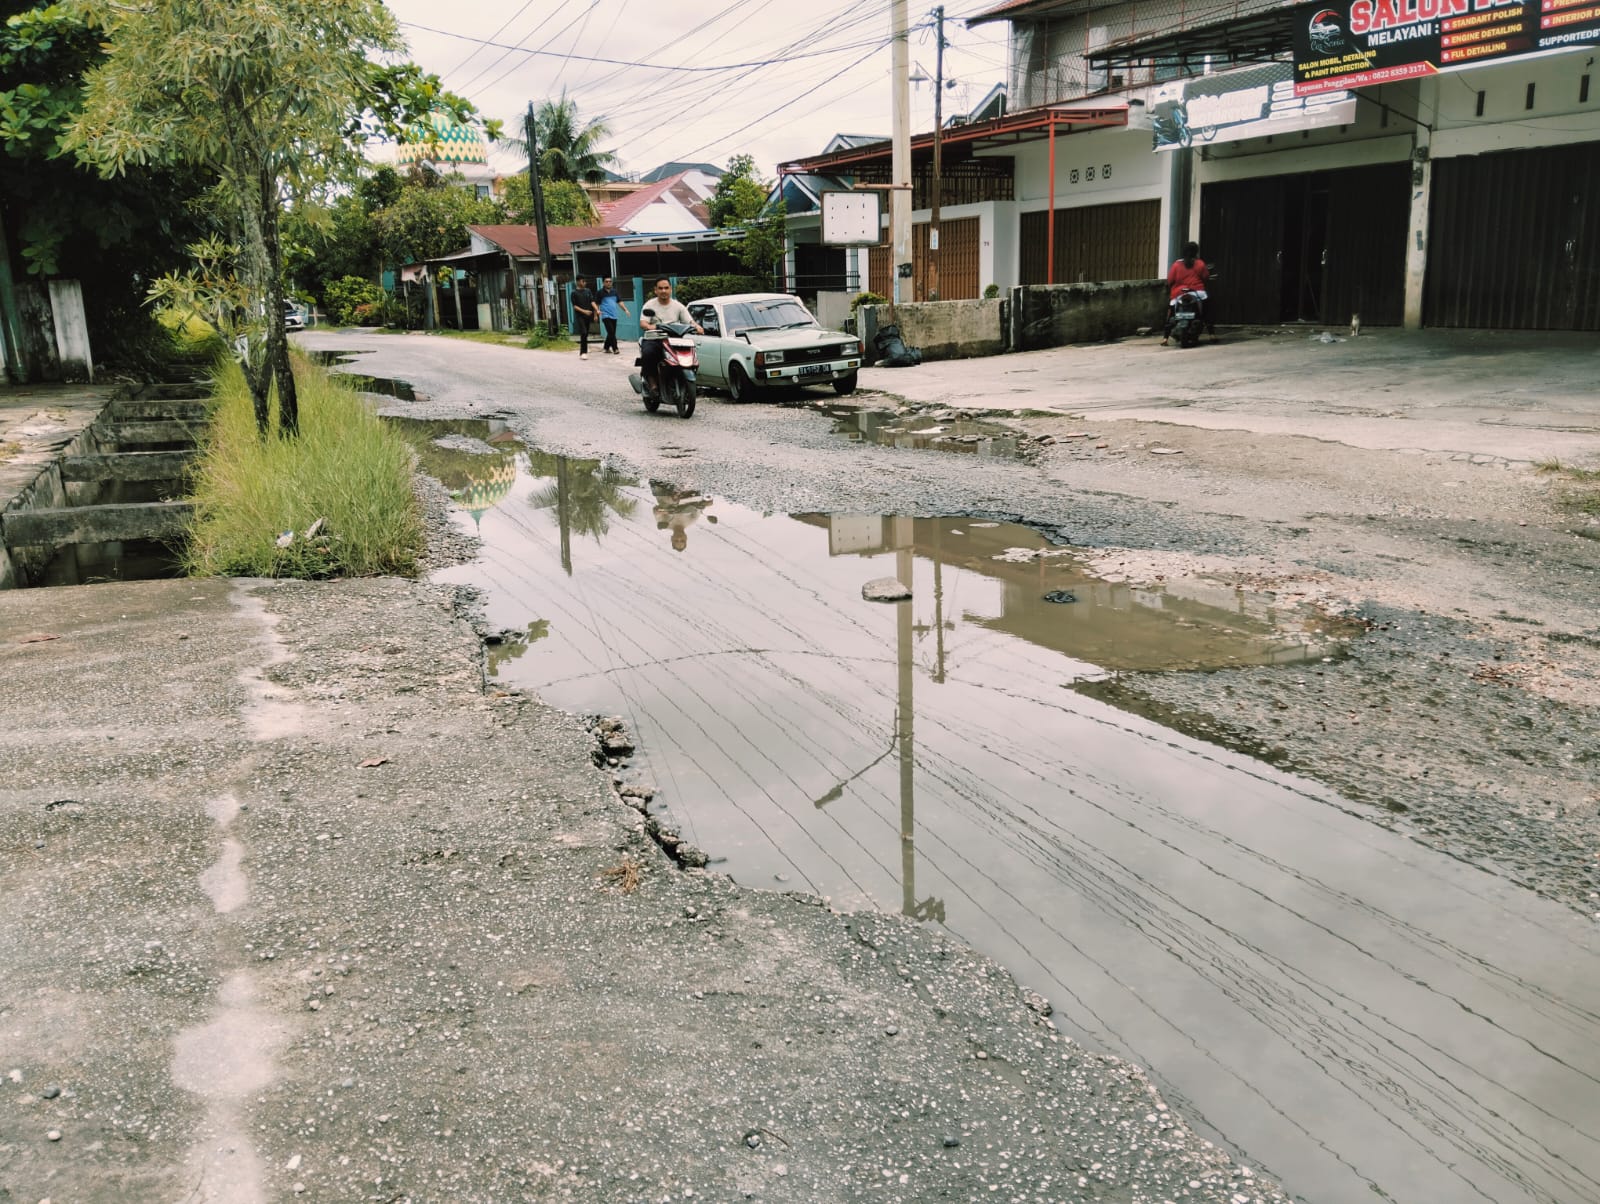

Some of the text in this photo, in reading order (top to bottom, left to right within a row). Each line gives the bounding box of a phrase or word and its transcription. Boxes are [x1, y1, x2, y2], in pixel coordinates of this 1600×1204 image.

[1451, 7, 1523, 28] STANDART POLISH
[1552, 9, 1593, 24] INTERIOR
[1367, 23, 1432, 47] MELAYANI
[1451, 23, 1523, 44] ENGINE DETAILING
[1539, 29, 1600, 47] SUPPORTEDB
[1298, 60, 1320, 71] SALON
[1342, 49, 1377, 63] DETAILING
[1451, 42, 1507, 59] FUL DETAILING
[1311, 68, 1329, 78] PAINT
[1329, 61, 1370, 75] PROTECTION
